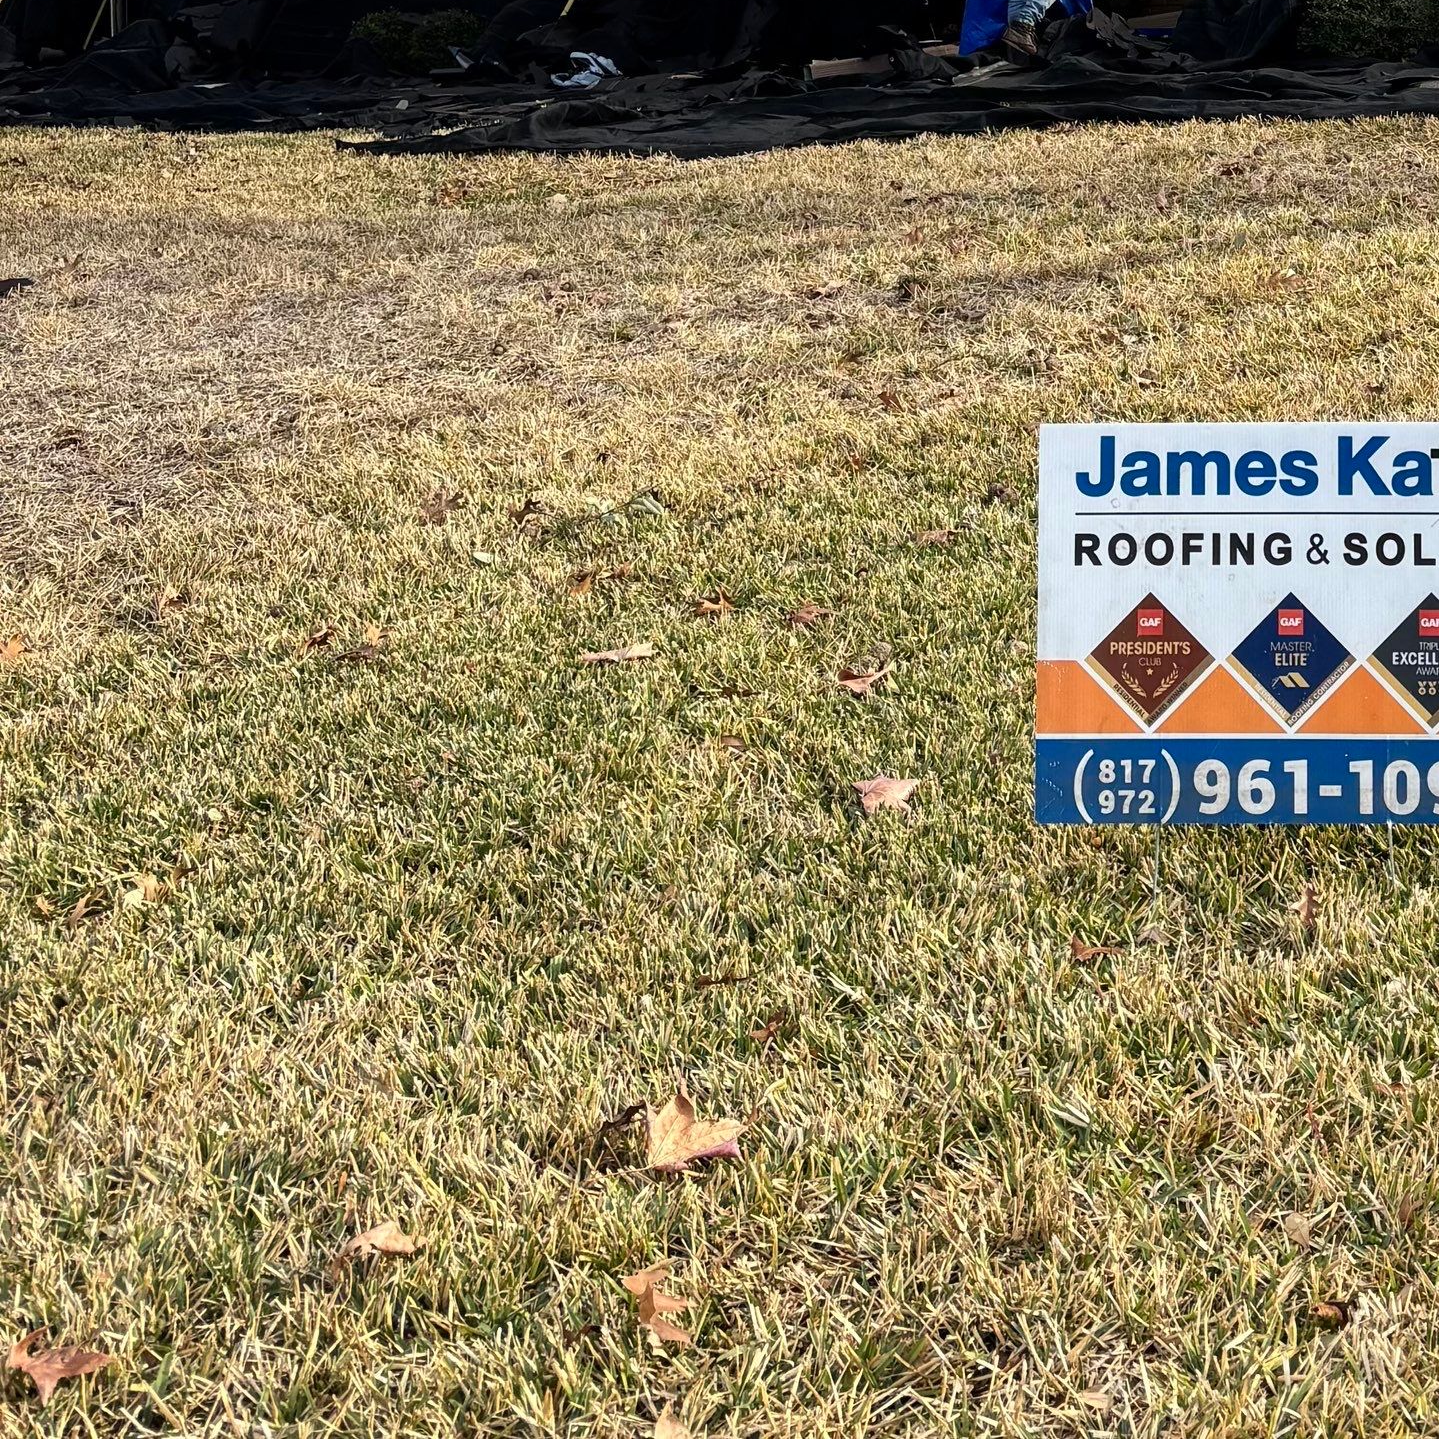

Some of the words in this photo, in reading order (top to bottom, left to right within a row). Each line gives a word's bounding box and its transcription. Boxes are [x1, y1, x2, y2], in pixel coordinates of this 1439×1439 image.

[1075, 435, 1319, 498] James
[1074, 532, 1293, 567] ROOFING
[1306, 533, 1330, 566] &
[1139, 617, 1162, 627] GAF
[1280, 617, 1303, 627] GAF
[1109, 641, 1191, 656] PRESIDENT'S
[1270, 641, 1312, 652] MASTER
[1138, 657, 1162, 666] CLUB
[1274, 652, 1307, 667] ELITE
[1312, 660, 1351, 700] CONTRACTOR
[1112, 682, 1147, 719] RESIDENTIAL
